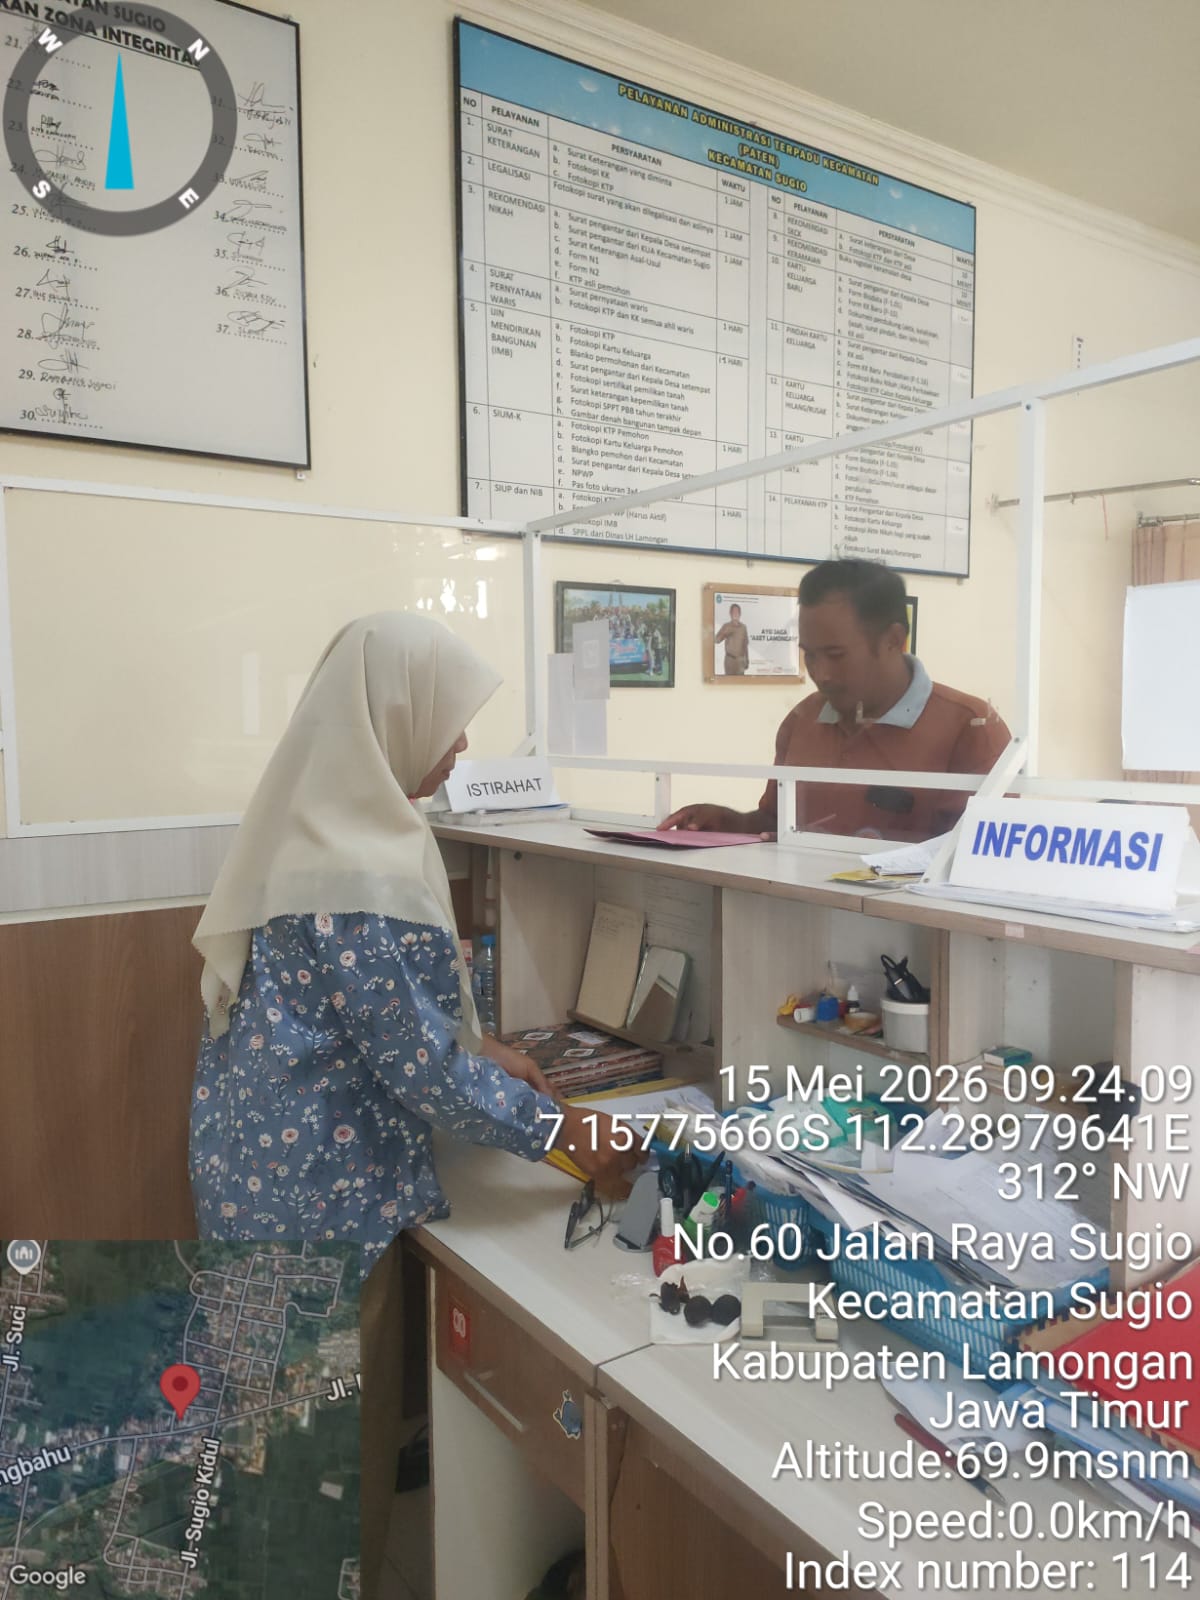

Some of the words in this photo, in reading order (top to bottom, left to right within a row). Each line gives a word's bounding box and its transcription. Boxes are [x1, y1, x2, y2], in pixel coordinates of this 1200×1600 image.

[44, 6, 97, 36] ZONA
[113, 5, 166, 33] SUGIO
[463, 97, 477, 108] NO
[491, 105, 540, 127] PELAYANAN
[487, 123, 513, 136] SURAT
[618, 83, 688, 119] PELAYANAN
[691, 111, 772, 147] ADMINISTRASI
[774, 140, 821, 165] TERPADU
[822, 155, 880, 186] KECAMATAN
[487, 136, 540, 158] KETERANGAN
[611, 143, 662, 166] PERSYARATAN
[467, 156, 475, 165] 2.
[738, 143, 781, 168] (PATEN)
[487, 162, 531, 181] LEGALISASI
[568, 147, 586, 160] Surat
[588, 155, 628, 173] Keterangan
[629, 168, 646, 181] yang
[568, 160, 600, 176] Fotokopi
[707, 148, 773, 180] KECAMATAN
[775, 173, 808, 192] SUGIO
[568, 172, 600, 188] Fotokopi
[601, 182, 614, 191] KTP
[721, 179, 746, 192] WAKTU
[468, 185, 475, 194] 3.
[553, 180, 586, 197] Fotokopi
[587, 191, 605, 203] surat
[606, 198, 623, 210] yang
[488, 190, 546, 213] REKOMENDASI
[12, 203, 29, 217] 25.
[488, 203, 514, 217] NIKAH
[793, 202, 828, 219] PELAYANAN
[13, 245, 31, 258] 26.
[214, 248, 229, 260] 35.
[569, 250, 588, 260] Form
[589, 255, 599, 264] N1
[469, 264, 478, 272] 4.
[489, 268, 514, 281] SURAT
[569, 262, 588, 273] Form
[589, 267, 600, 277] N2
[15, 286, 33, 299] 27.
[215, 286, 230, 297] 36.
[490, 281, 542, 300] PERNYATAAN
[569, 275, 583, 284] KTP
[597, 283, 631, 296] pemohon
[470, 303, 478, 312] 5.
[490, 294, 516, 307] WARIS
[17, 328, 34, 340] 28.
[216, 323, 231, 335] 37.
[490, 320, 541, 338] MENDIRIKAN
[570, 324, 600, 338] Fotokopi
[602, 332, 615, 340] KTP
[491, 333, 537, 349] BANGUNAN
[491, 346, 513, 358] (IMB)
[18, 368, 36, 381] 29.
[570, 361, 589, 372] Surat
[590, 366, 626, 379] pengantar
[627, 371, 640, 381] dari
[641, 375, 663, 386] Kepala
[664, 379, 680, 389] Desa
[19, 409, 37, 421] 30.
[473, 406, 480, 415] 6.
[492, 409, 522, 421] SIUM-K
[570, 397, 601, 410] Fotokopi
[603, 402, 620, 412] SPPT
[621, 405, 634, 414] PBB
[636, 408, 655, 418] tahun
[571, 409, 599, 420] Gambar
[600, 414, 622, 423] denah
[623, 418, 656, 429] bangunan
[571, 421, 601, 433] Fotokopi
[603, 427, 616, 435] KTP
[617, 429, 649, 440] Pemohon
[571, 433, 601, 445] Fotokopi
[604, 439, 622, 448] Kartu
[623, 441, 652, 452] Keluarga
[653, 445, 683, 456] Pemohon
[572, 468, 593, 478] NPWP
[475, 482, 482, 490] 7.
[494, 484, 512, 493] SIUP
[514, 486, 528, 495] dan
[530, 488, 543, 497] NIB
[572, 480, 584, 489] Pas
[586, 482, 600, 490] foto
[601, 484, 625, 494] ukuran
[466, 777, 543, 798] ISTIRAHAT
[971, 820, 1164, 872] INFORMASI
